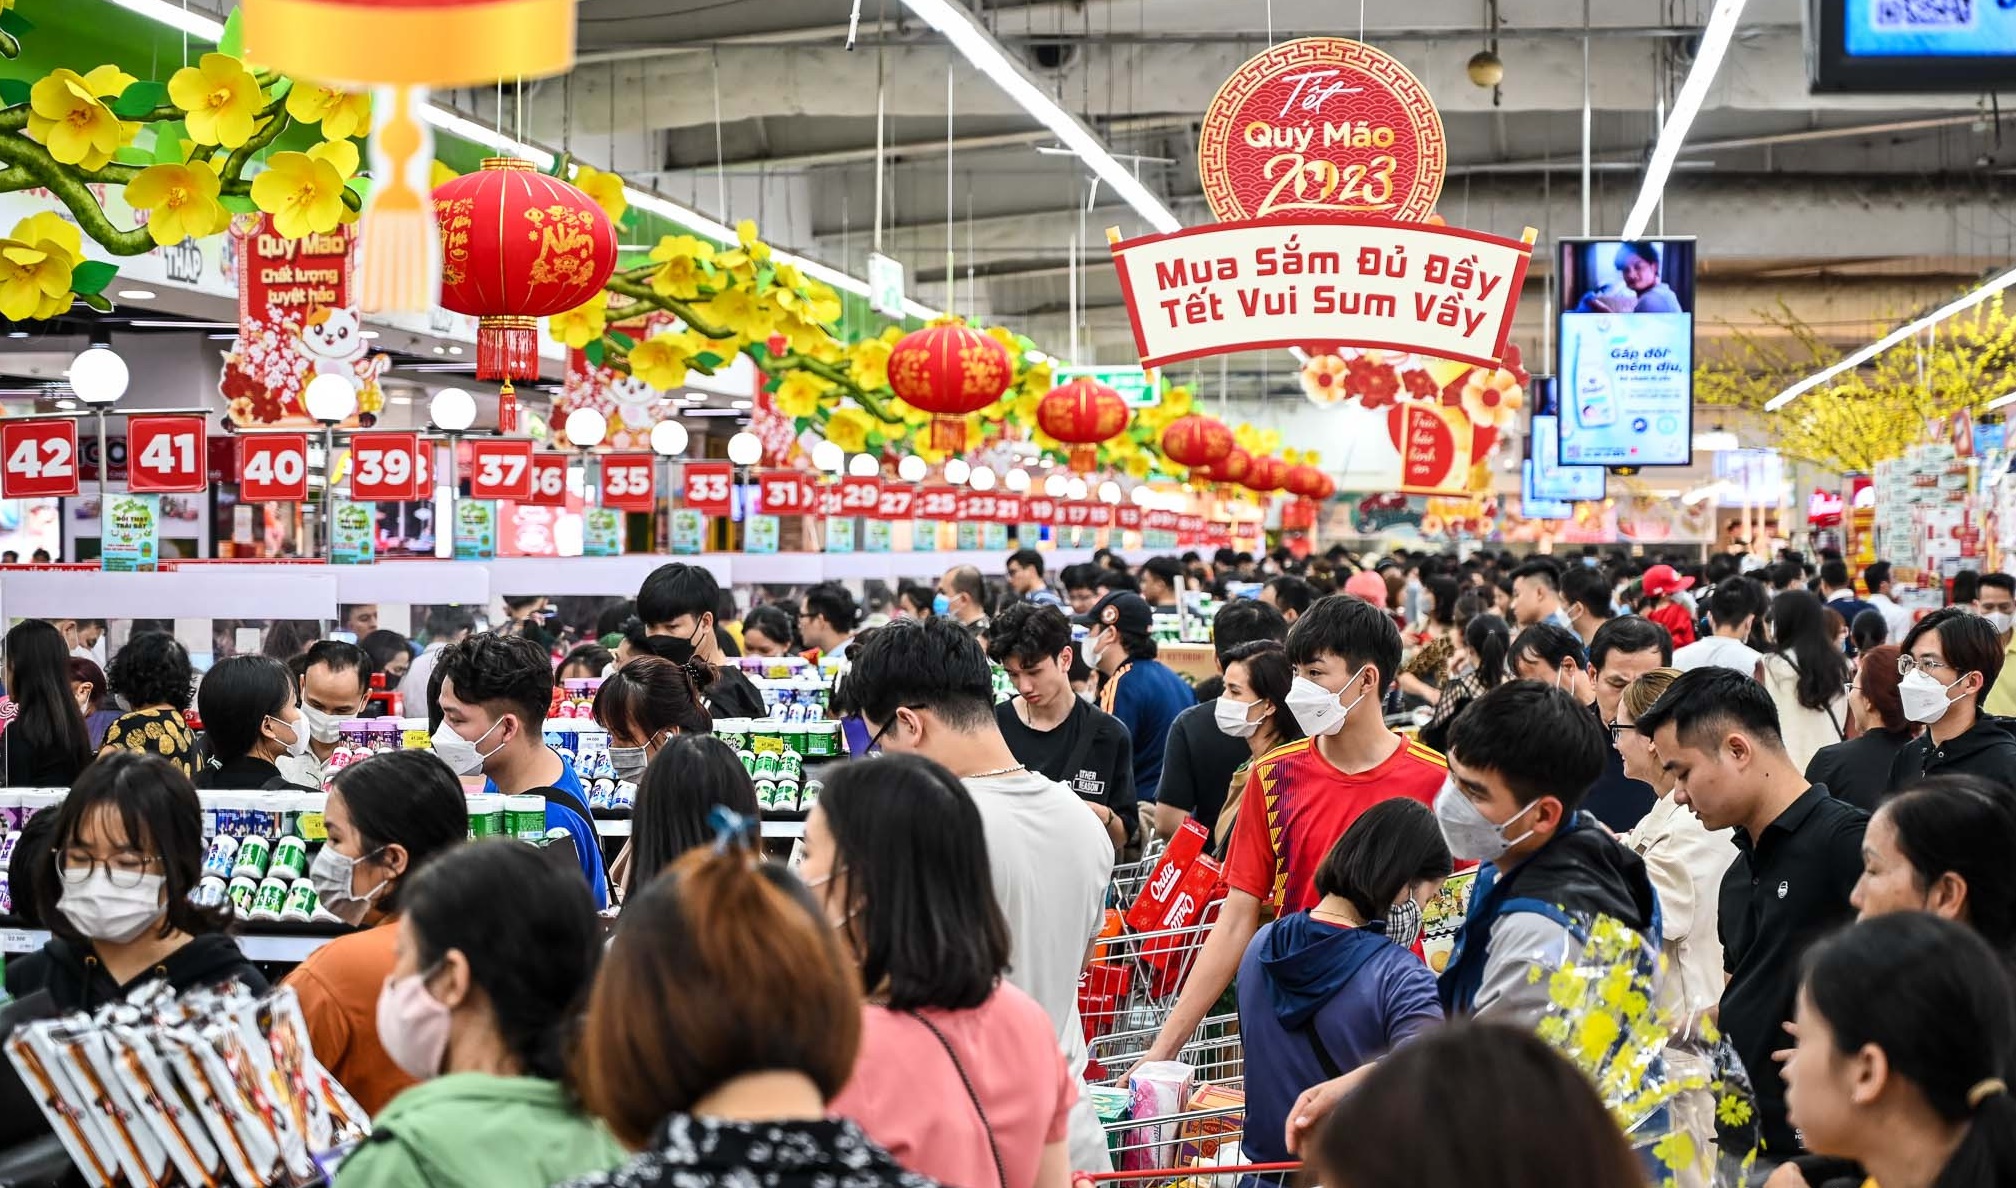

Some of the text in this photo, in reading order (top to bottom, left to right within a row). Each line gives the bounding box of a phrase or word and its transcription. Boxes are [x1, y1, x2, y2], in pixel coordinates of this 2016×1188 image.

[1282, 70, 1363, 117] Tết
[1244, 122, 1395, 153] Quý Mão
[1258, 153, 1397, 218] 2023
[1155, 234, 1502, 300] Mua Sắm Đủ Đầy
[1160, 284, 1487, 338] Tết Vui Sum Vầy
[7, 437, 73, 478] 42
[139, 433, 196, 474] 41
[244, 450, 304, 485] 40
[356, 449, 411, 485] 39
[477, 454, 527, 486] 37
[606, 466, 650, 495] 35
[688, 474, 728, 501] 33
[766, 481, 798, 506] 31
[843, 484, 878, 507] 29
[879, 492, 912, 514] 27
[924, 493, 956, 514] 25
[967, 495, 996, 515] 23
[996, 500, 1020, 518] 21
